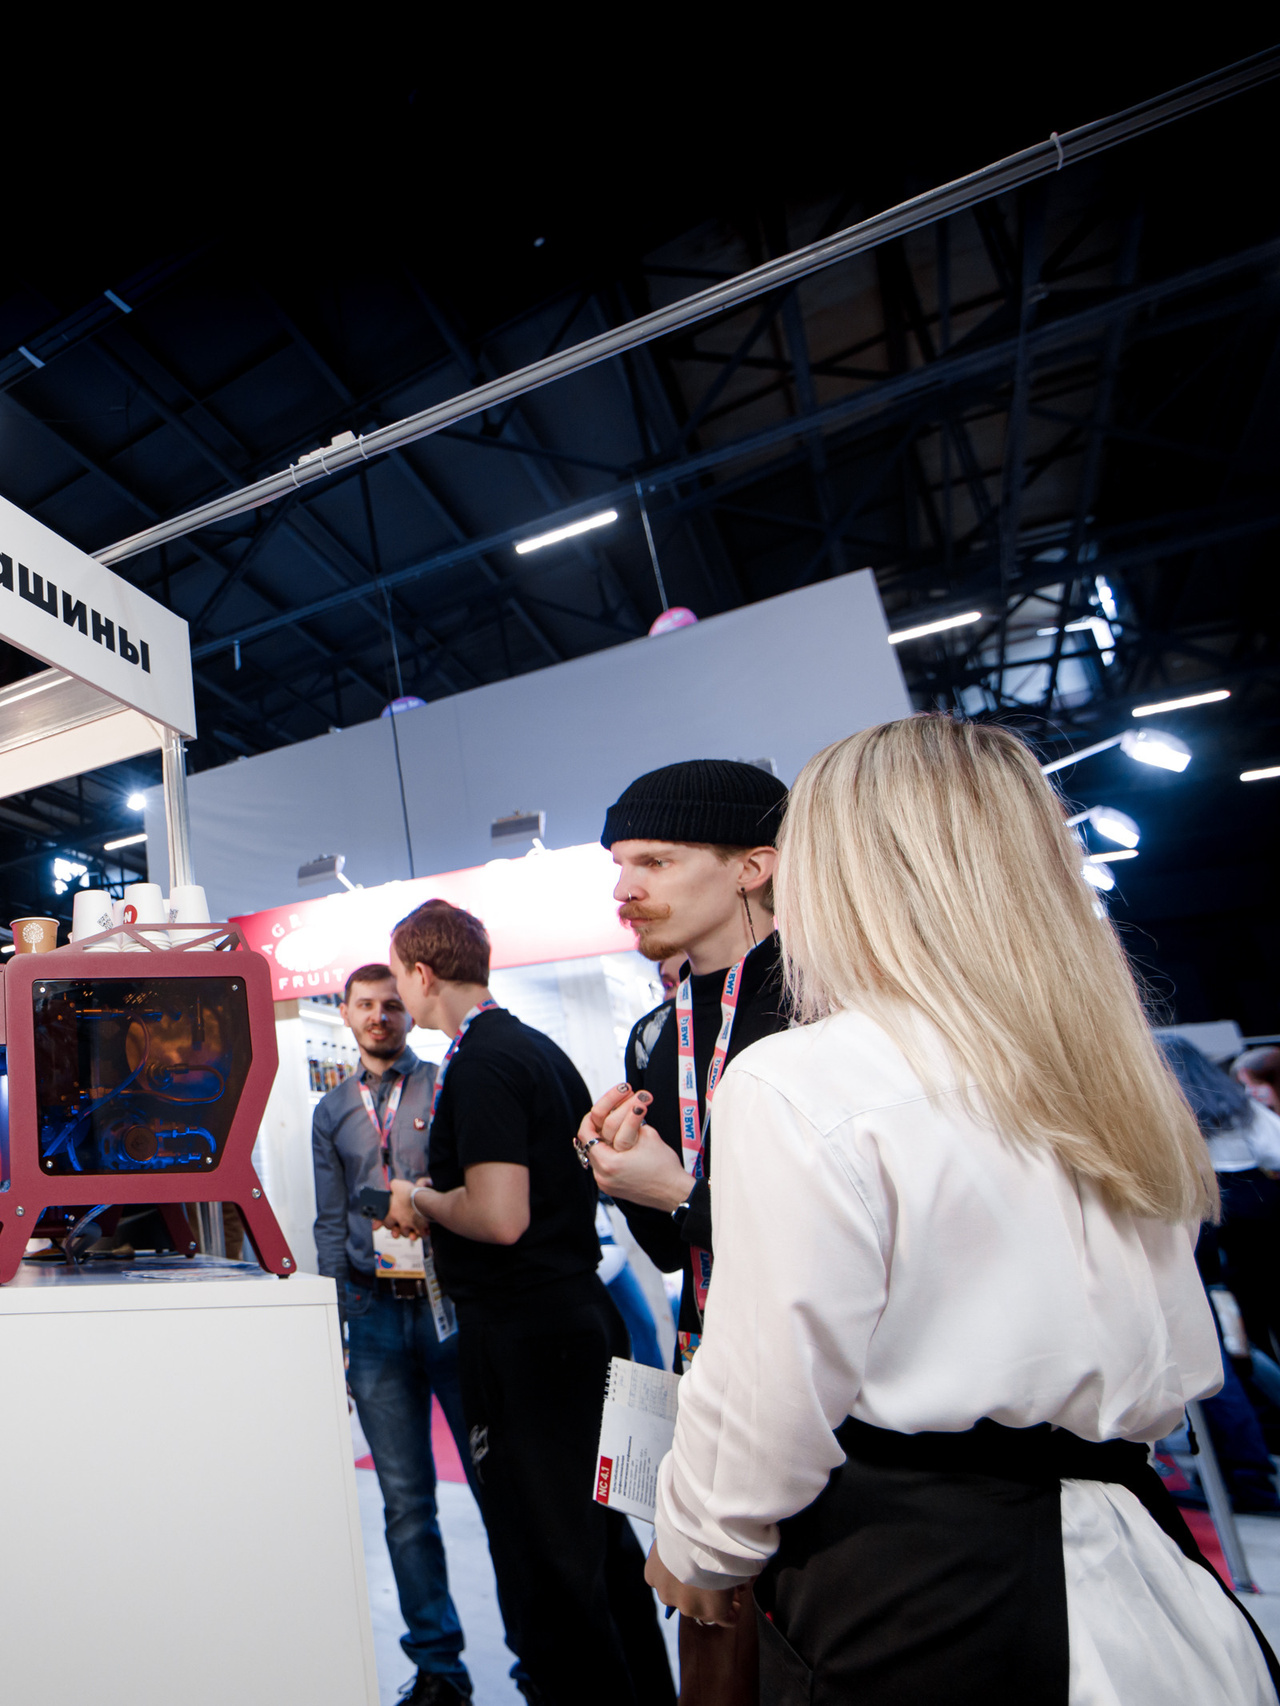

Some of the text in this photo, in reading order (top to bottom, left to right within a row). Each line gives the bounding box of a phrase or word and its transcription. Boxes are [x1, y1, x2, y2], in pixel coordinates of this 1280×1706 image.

[278, 968, 345, 991] FRUIT
[725, 972, 737, 996] BWT
[681, 1025, 690, 1048] BWT
[684, 1116, 695, 1140] BWT
[598, 1466, 610, 1497] NC 4.1
